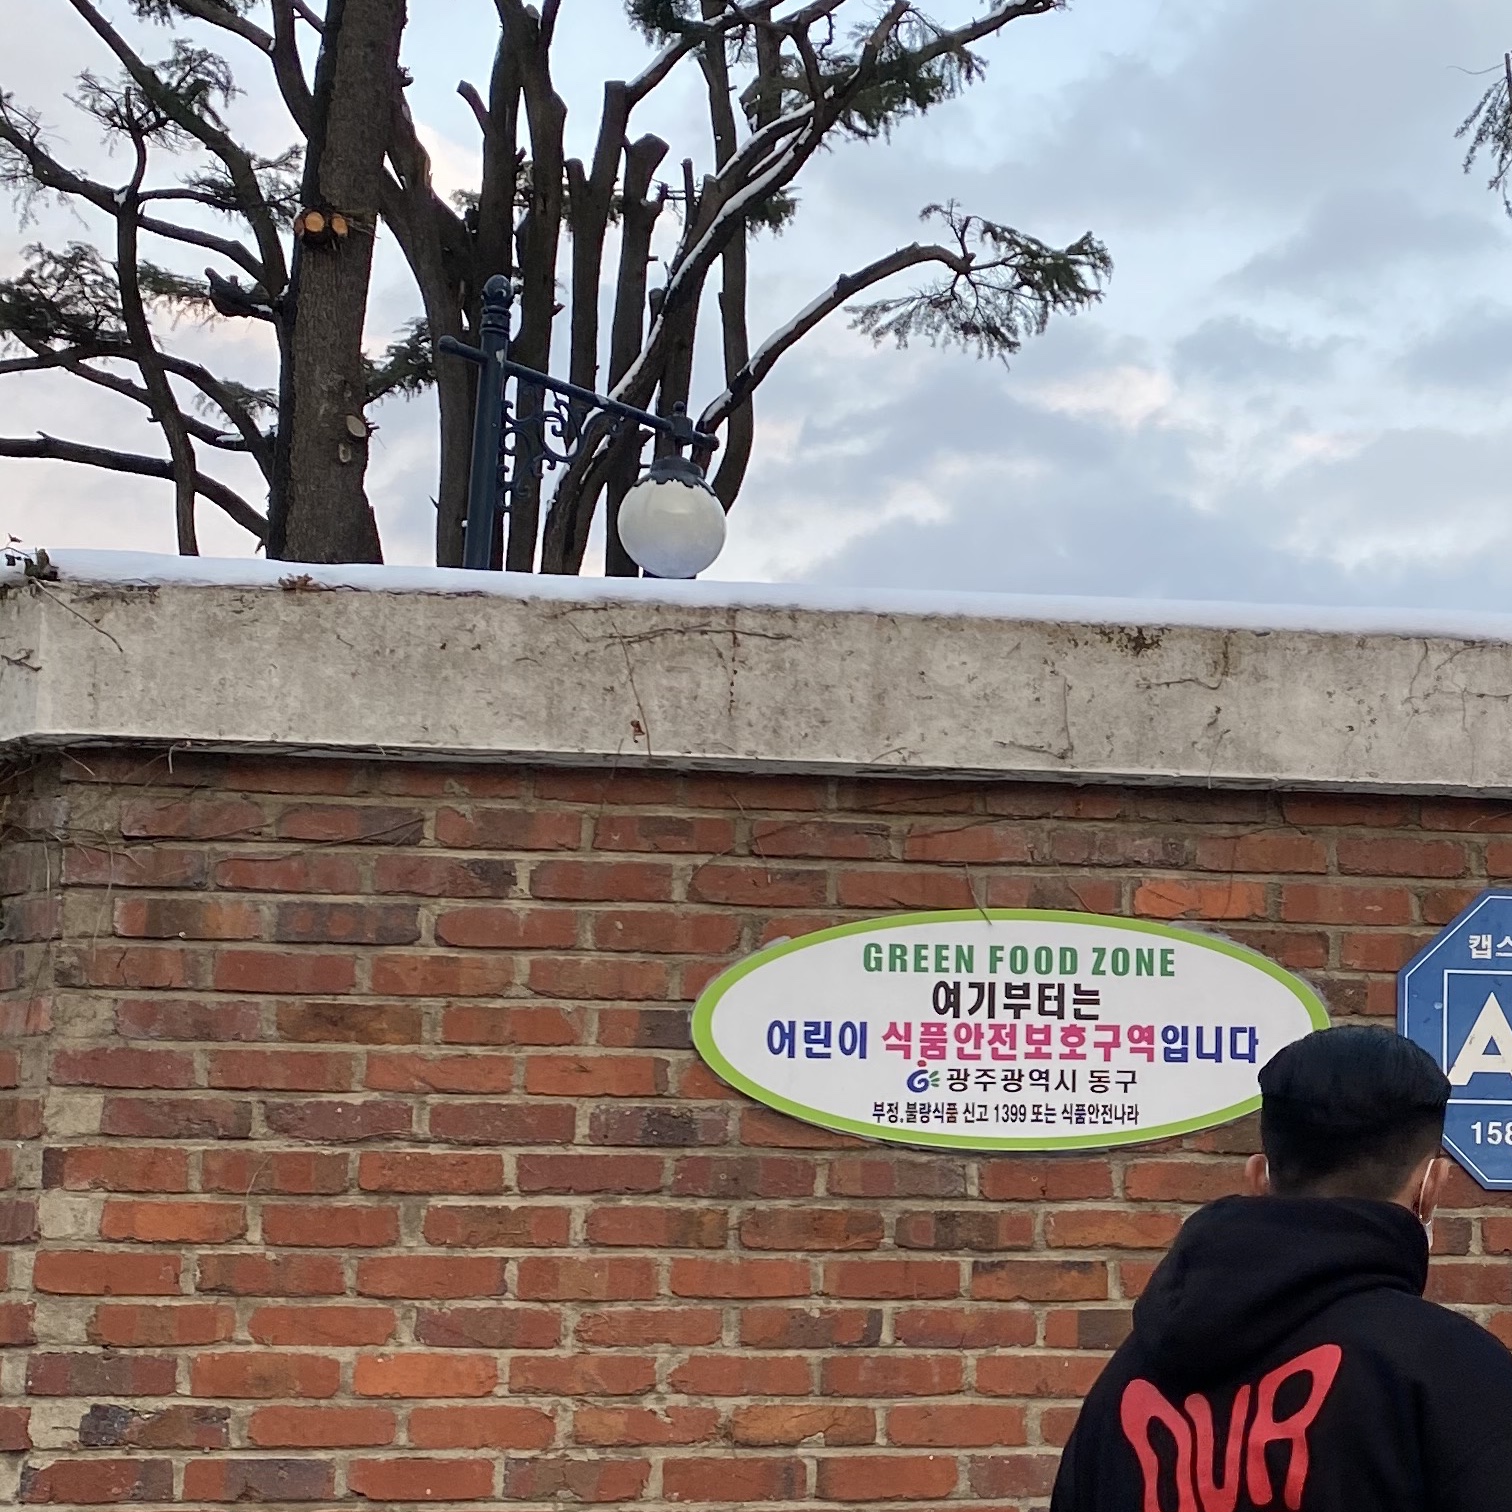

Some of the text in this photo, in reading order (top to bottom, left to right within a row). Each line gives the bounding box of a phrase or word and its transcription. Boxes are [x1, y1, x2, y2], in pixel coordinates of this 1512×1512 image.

[863, 942, 1176, 978] GREEN FOOD ZONE
[932, 980, 1101, 1020] 여기부터는
[767, 1019, 1260, 1065] 어린이 식품안전보호구역입니다
[946, 1067, 1138, 1095] 광주광역시 동구
[962, 1102, 989, 1124] 신고
[993, 1103, 1027, 1124] 1399
[1030, 1103, 1057, 1125] 또는
[1061, 1103, 1140, 1126] 식품안전나라
